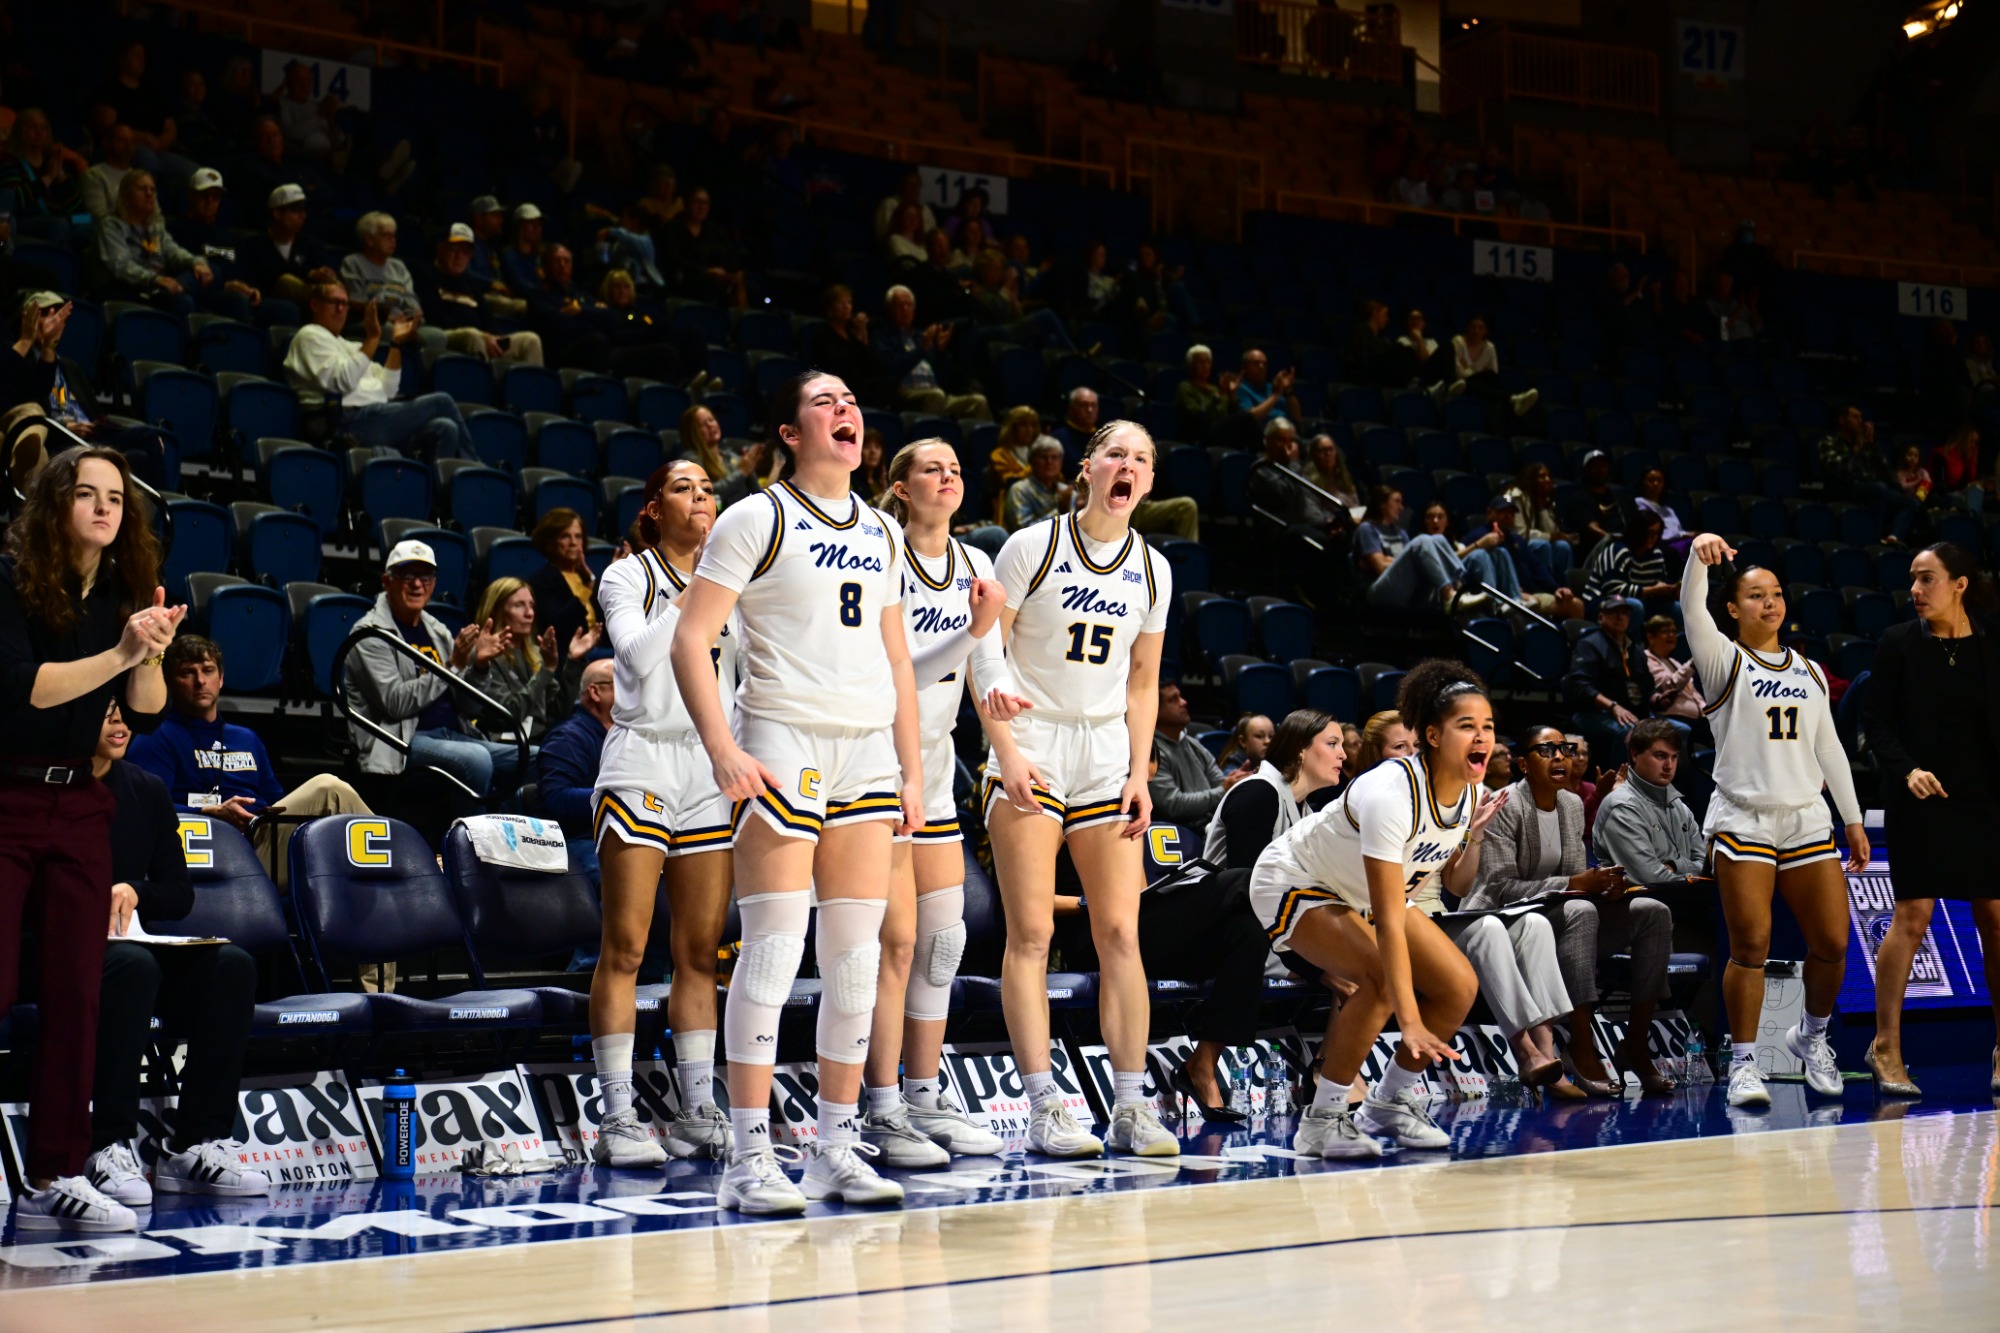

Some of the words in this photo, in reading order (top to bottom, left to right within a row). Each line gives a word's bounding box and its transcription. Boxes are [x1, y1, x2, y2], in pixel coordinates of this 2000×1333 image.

[1684, 28, 1737, 72] 217
[284, 59, 350, 102] 14
[1488, 245, 1537, 277] 115
[1911, 286, 1953, 316] 116
[809, 542, 884, 573] Mocs
[839, 581, 862, 629] 8
[1061, 585, 1129, 618] Mocs
[912, 606, 968, 634] Mocs
[1065, 621, 1116, 666] 15
[1751, 678, 1809, 699] Mocs
[1765, 706, 1799, 740] 11
[345, 818, 392, 868] C
[1147, 825, 1184, 866] C
[279, 1012, 339, 1024] CHATTANOOGA
[450, 1008, 509, 1020] CHATTANOOGA
[399, 1101, 410, 1167] POWERADE
[991, 1117, 1018, 1131] DAN
[238, 1147, 304, 1164] WEALTH
[314, 1140, 367, 1157] GROUP
[280, 1160, 352, 1183] NORTON
